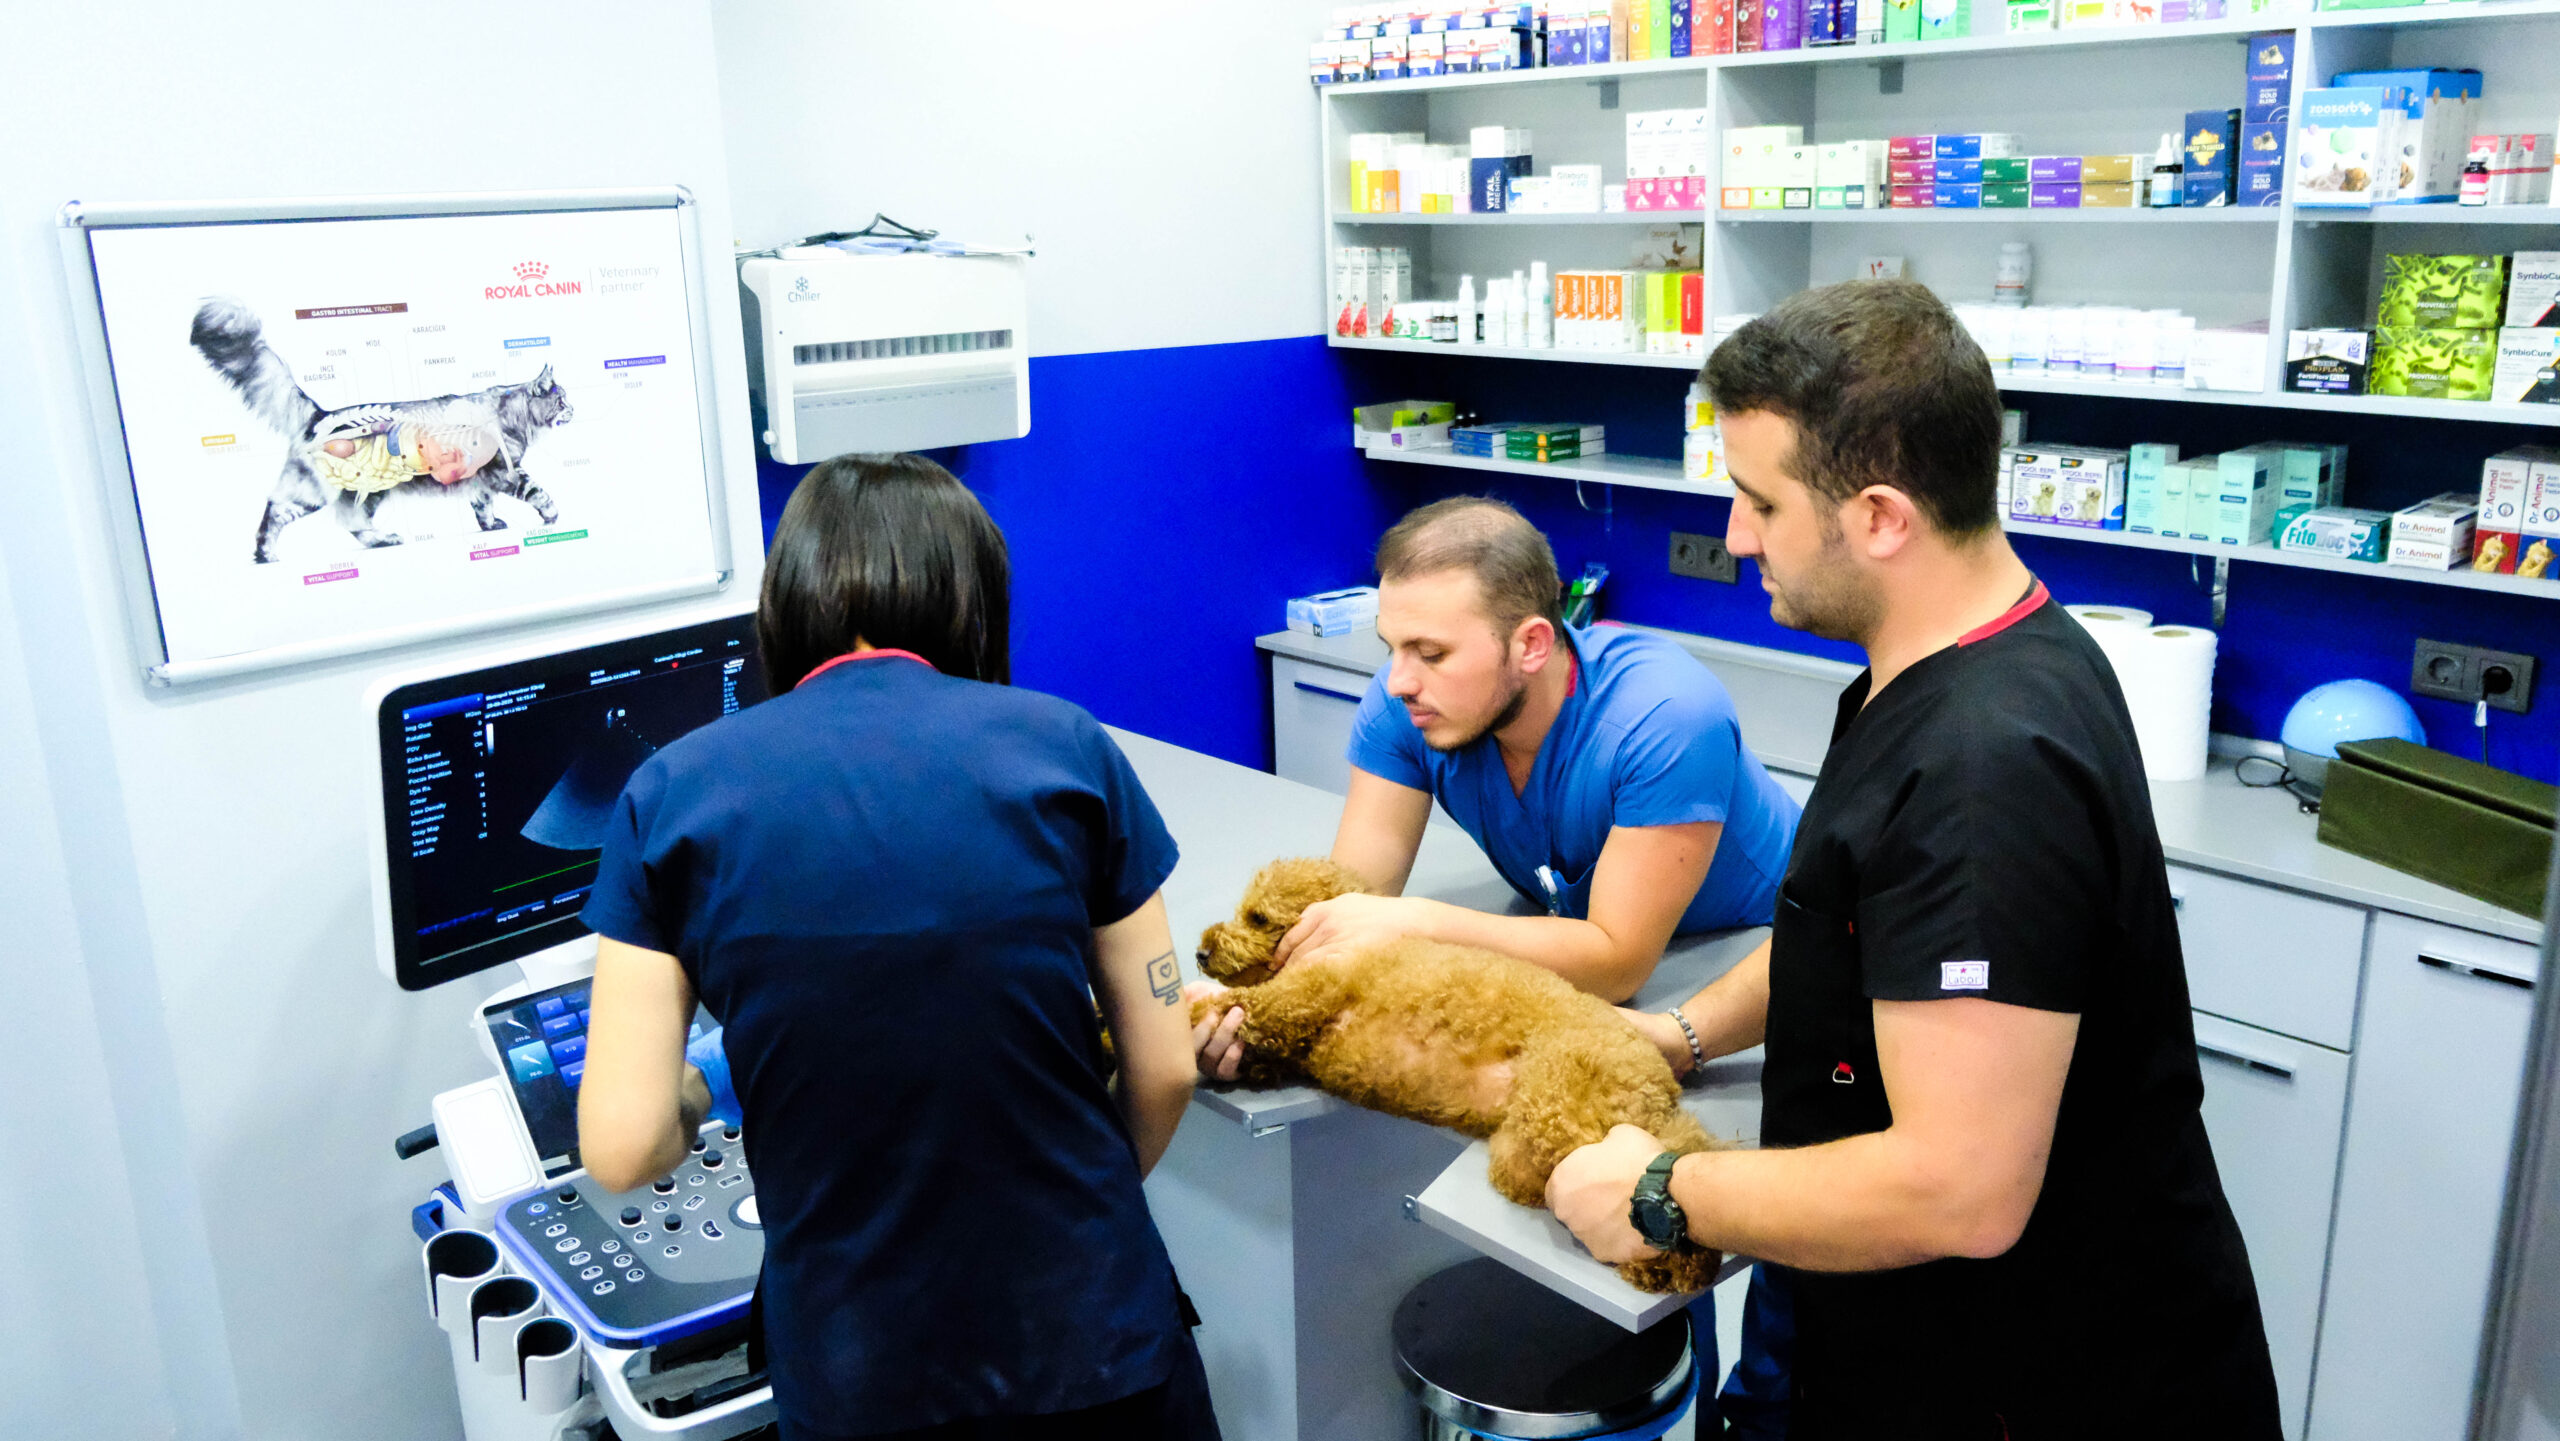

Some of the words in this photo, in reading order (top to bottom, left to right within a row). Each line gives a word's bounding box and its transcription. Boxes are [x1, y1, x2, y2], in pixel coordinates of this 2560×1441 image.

[2310, 101, 2359, 114] zoosorb
[1487, 176, 1495, 210] VITAL
[599, 266, 660, 280] Veterinary
[485, 284, 532, 300] ROYAL
[534, 280, 582, 297] CANIN
[601, 281, 645, 296] partner
[787, 290, 821, 303] Chiller
[311, 309, 336, 317] GASTRO
[336, 307, 373, 316] INTESTINAL
[374, 305, 393, 313] TRACT
[2502, 347, 2552, 357] SynbioCure
[423, 356, 457, 366] PANKREAS
[607, 359, 628, 369] HEALTH
[474, 551, 490, 560] VITAL
[307, 575, 326, 584] VITAL
[405, 732, 432, 743] Rotation
[406, 745, 421, 754] FOV
[407, 766, 427, 775] Focus
[427, 760, 451, 770] Number
[408, 776, 428, 786] Focus
[427, 770, 453, 781] Position
[424, 802, 447, 813] Density
[411, 813, 445, 827] Persistence
[411, 828, 426, 838] Gray
[426, 825, 440, 835] Map
[425, 836, 439, 845] Map
[418, 846, 436, 856] Scale
